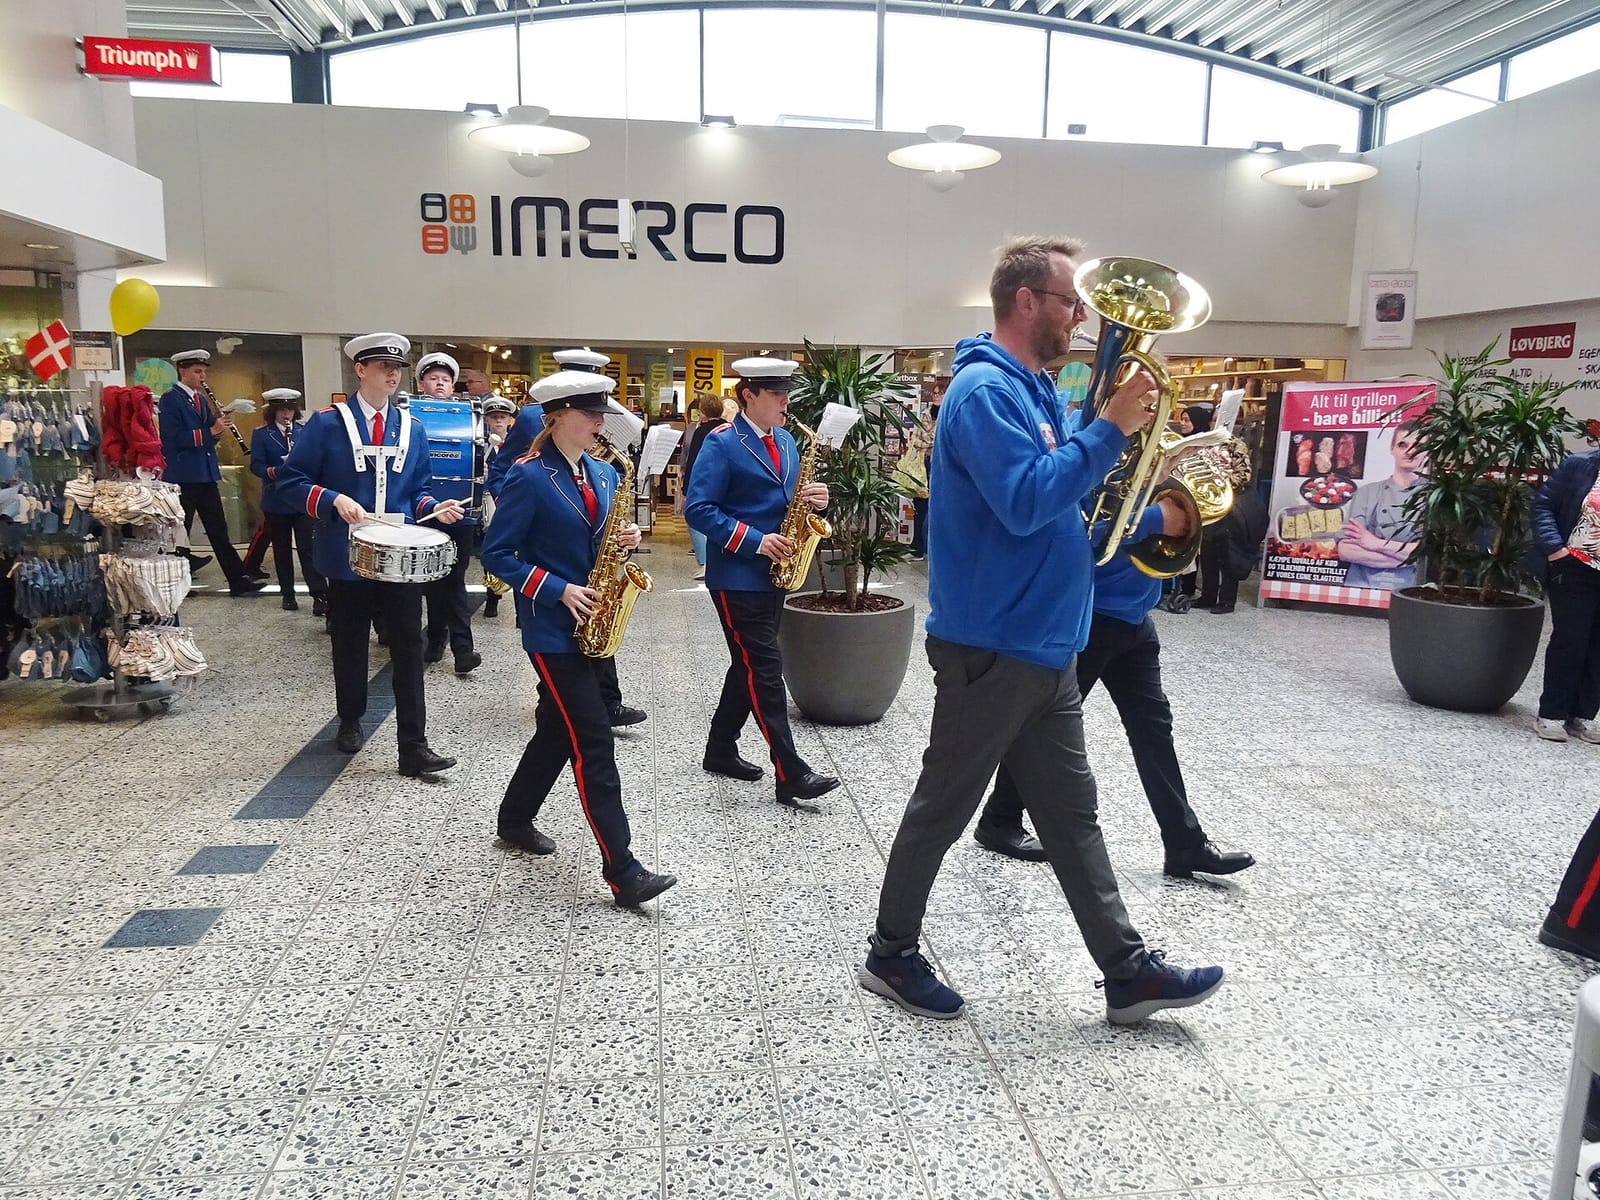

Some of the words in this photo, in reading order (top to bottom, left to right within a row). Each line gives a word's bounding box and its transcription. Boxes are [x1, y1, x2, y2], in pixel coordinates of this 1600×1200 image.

[95, 44, 182, 72] Triumph
[490, 194, 785, 265] IMERCO
[1511, 334, 1571, 352] LØVBJERG
[1509, 368, 1533, 378] ALTID
[1310, 394, 1330, 409] Alt
[1333, 393, 1347, 408] til
[1351, 391, 1397, 410] grillen
[1313, 411, 1348, 426] bare
